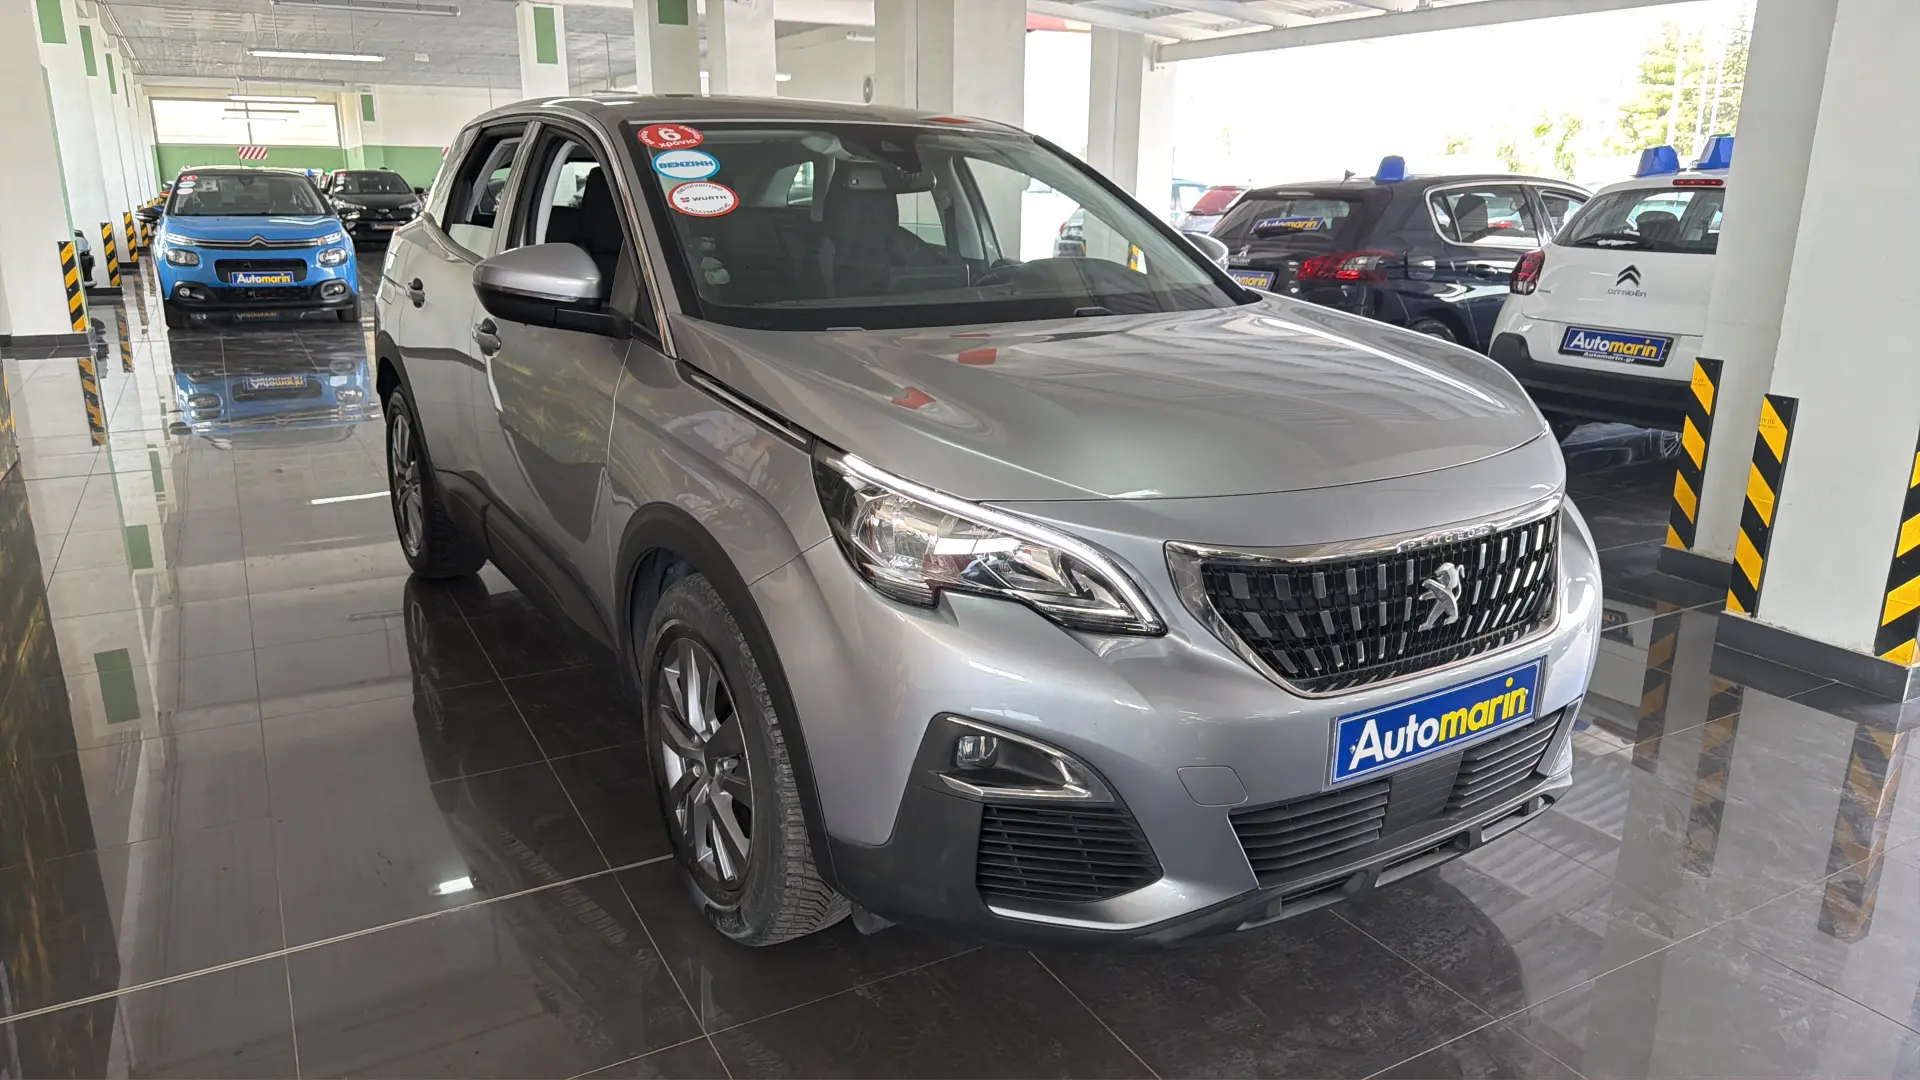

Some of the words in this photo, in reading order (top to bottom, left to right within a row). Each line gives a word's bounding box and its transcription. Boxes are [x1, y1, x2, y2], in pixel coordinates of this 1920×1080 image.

[658, 129, 681, 141] 6
[659, 138, 698, 148] χρόνια
[1259, 217, 1318, 229] Automarin
[236, 273, 291, 284] Automarin
[1233, 273, 1268, 287] tomarin
[1570, 331, 1658, 358] Automarin
[1583, 351, 1636, 363] Automarin.gr
[1348, 676, 1528, 771] Automarin
